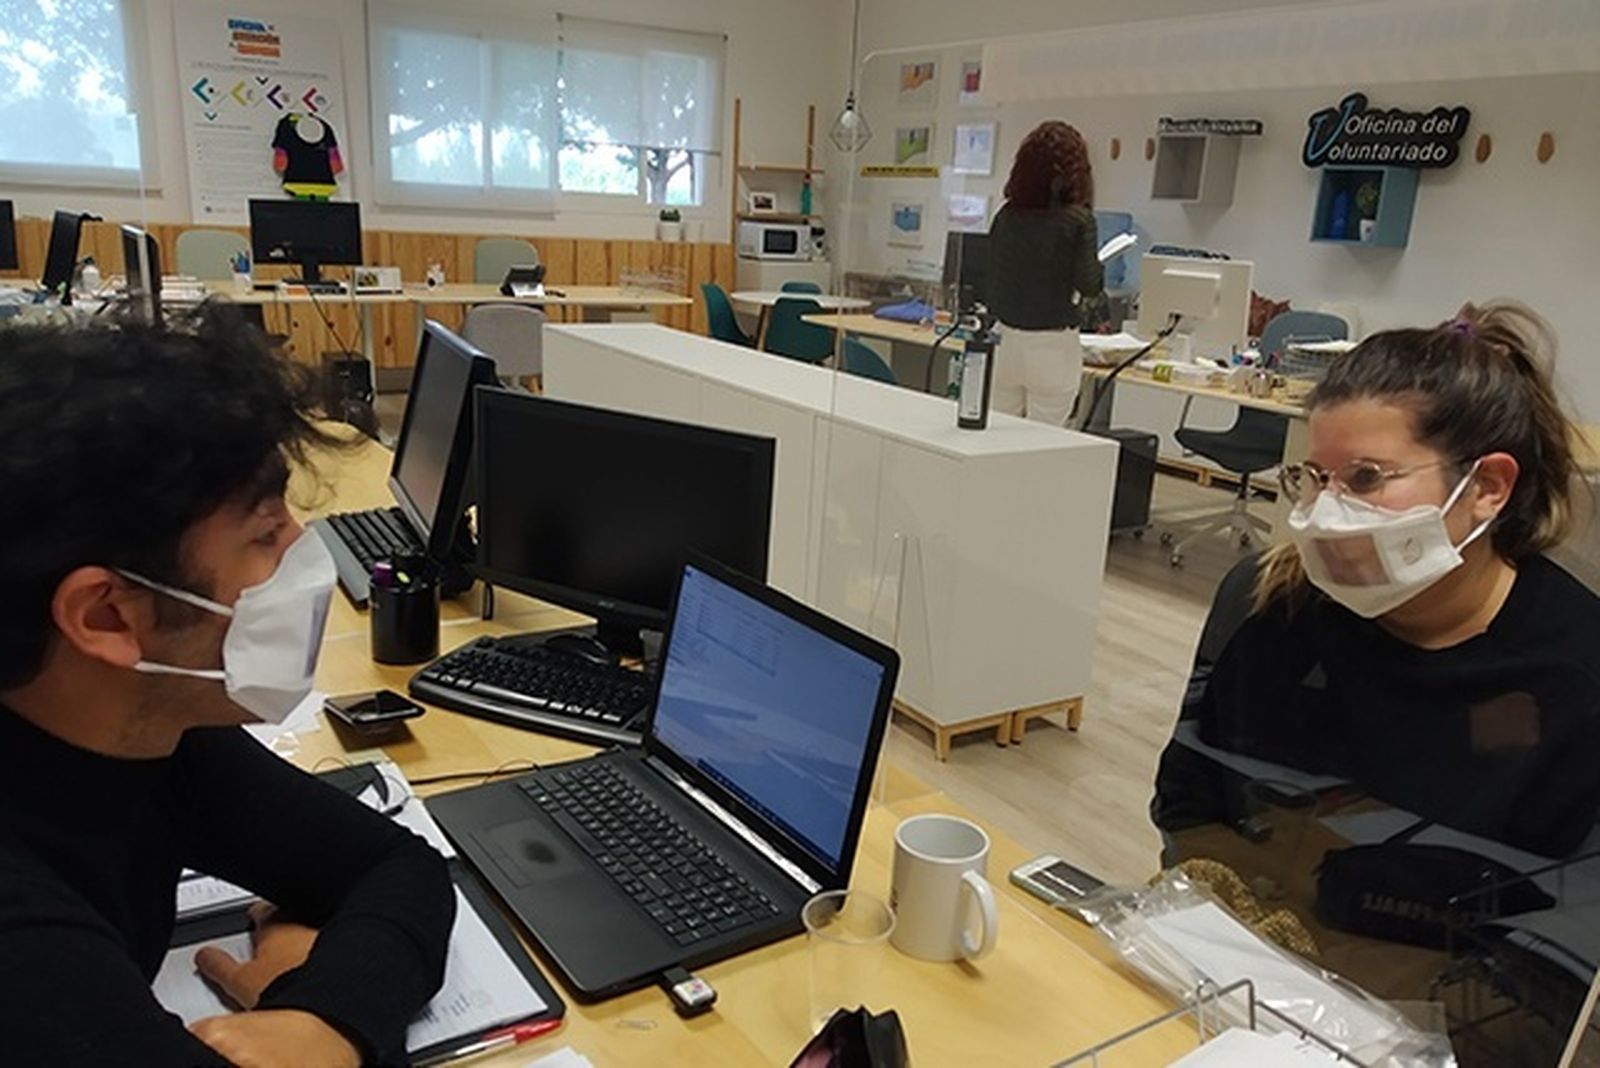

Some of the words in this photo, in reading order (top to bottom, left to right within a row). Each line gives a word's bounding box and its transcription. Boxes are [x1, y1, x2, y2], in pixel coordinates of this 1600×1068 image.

[1307, 101, 1449, 161] Voluntariado
[1344, 114, 1417, 134] Oficina
[1421, 113, 1459, 134] del
